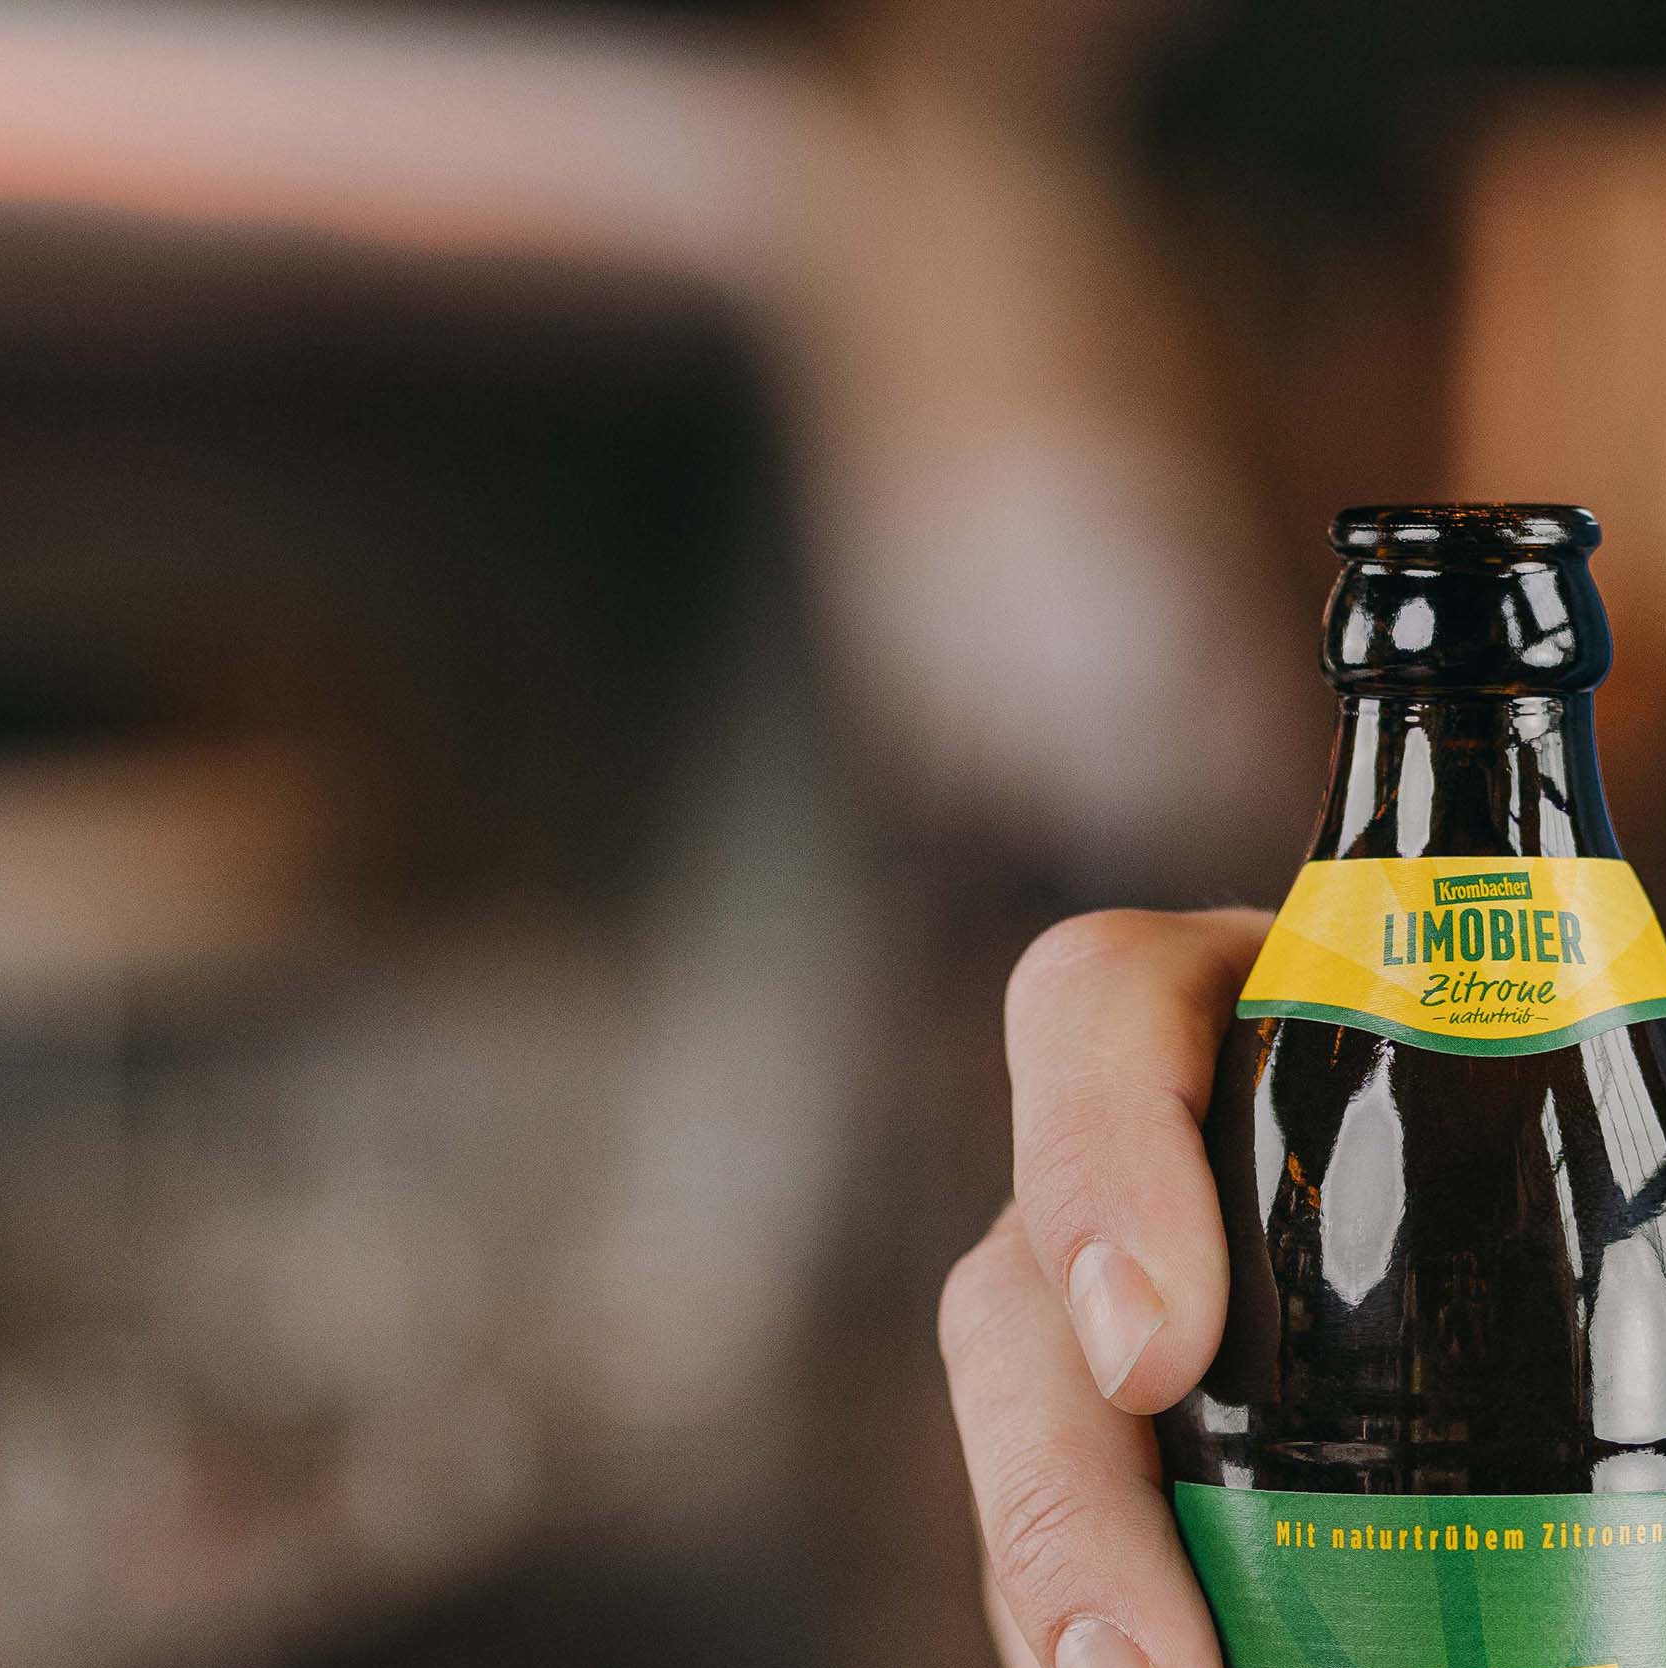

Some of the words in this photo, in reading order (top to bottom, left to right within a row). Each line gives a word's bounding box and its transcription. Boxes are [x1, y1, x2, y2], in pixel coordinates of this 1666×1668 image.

[1438, 876, 1528, 901] Krombacher
[1383, 907, 1586, 967] LIMOBIER
[1419, 970, 1557, 1007] Zitrone
[1276, 1520, 1316, 1548] Mit
[1331, 1520, 1525, 1550] naturtrübem
